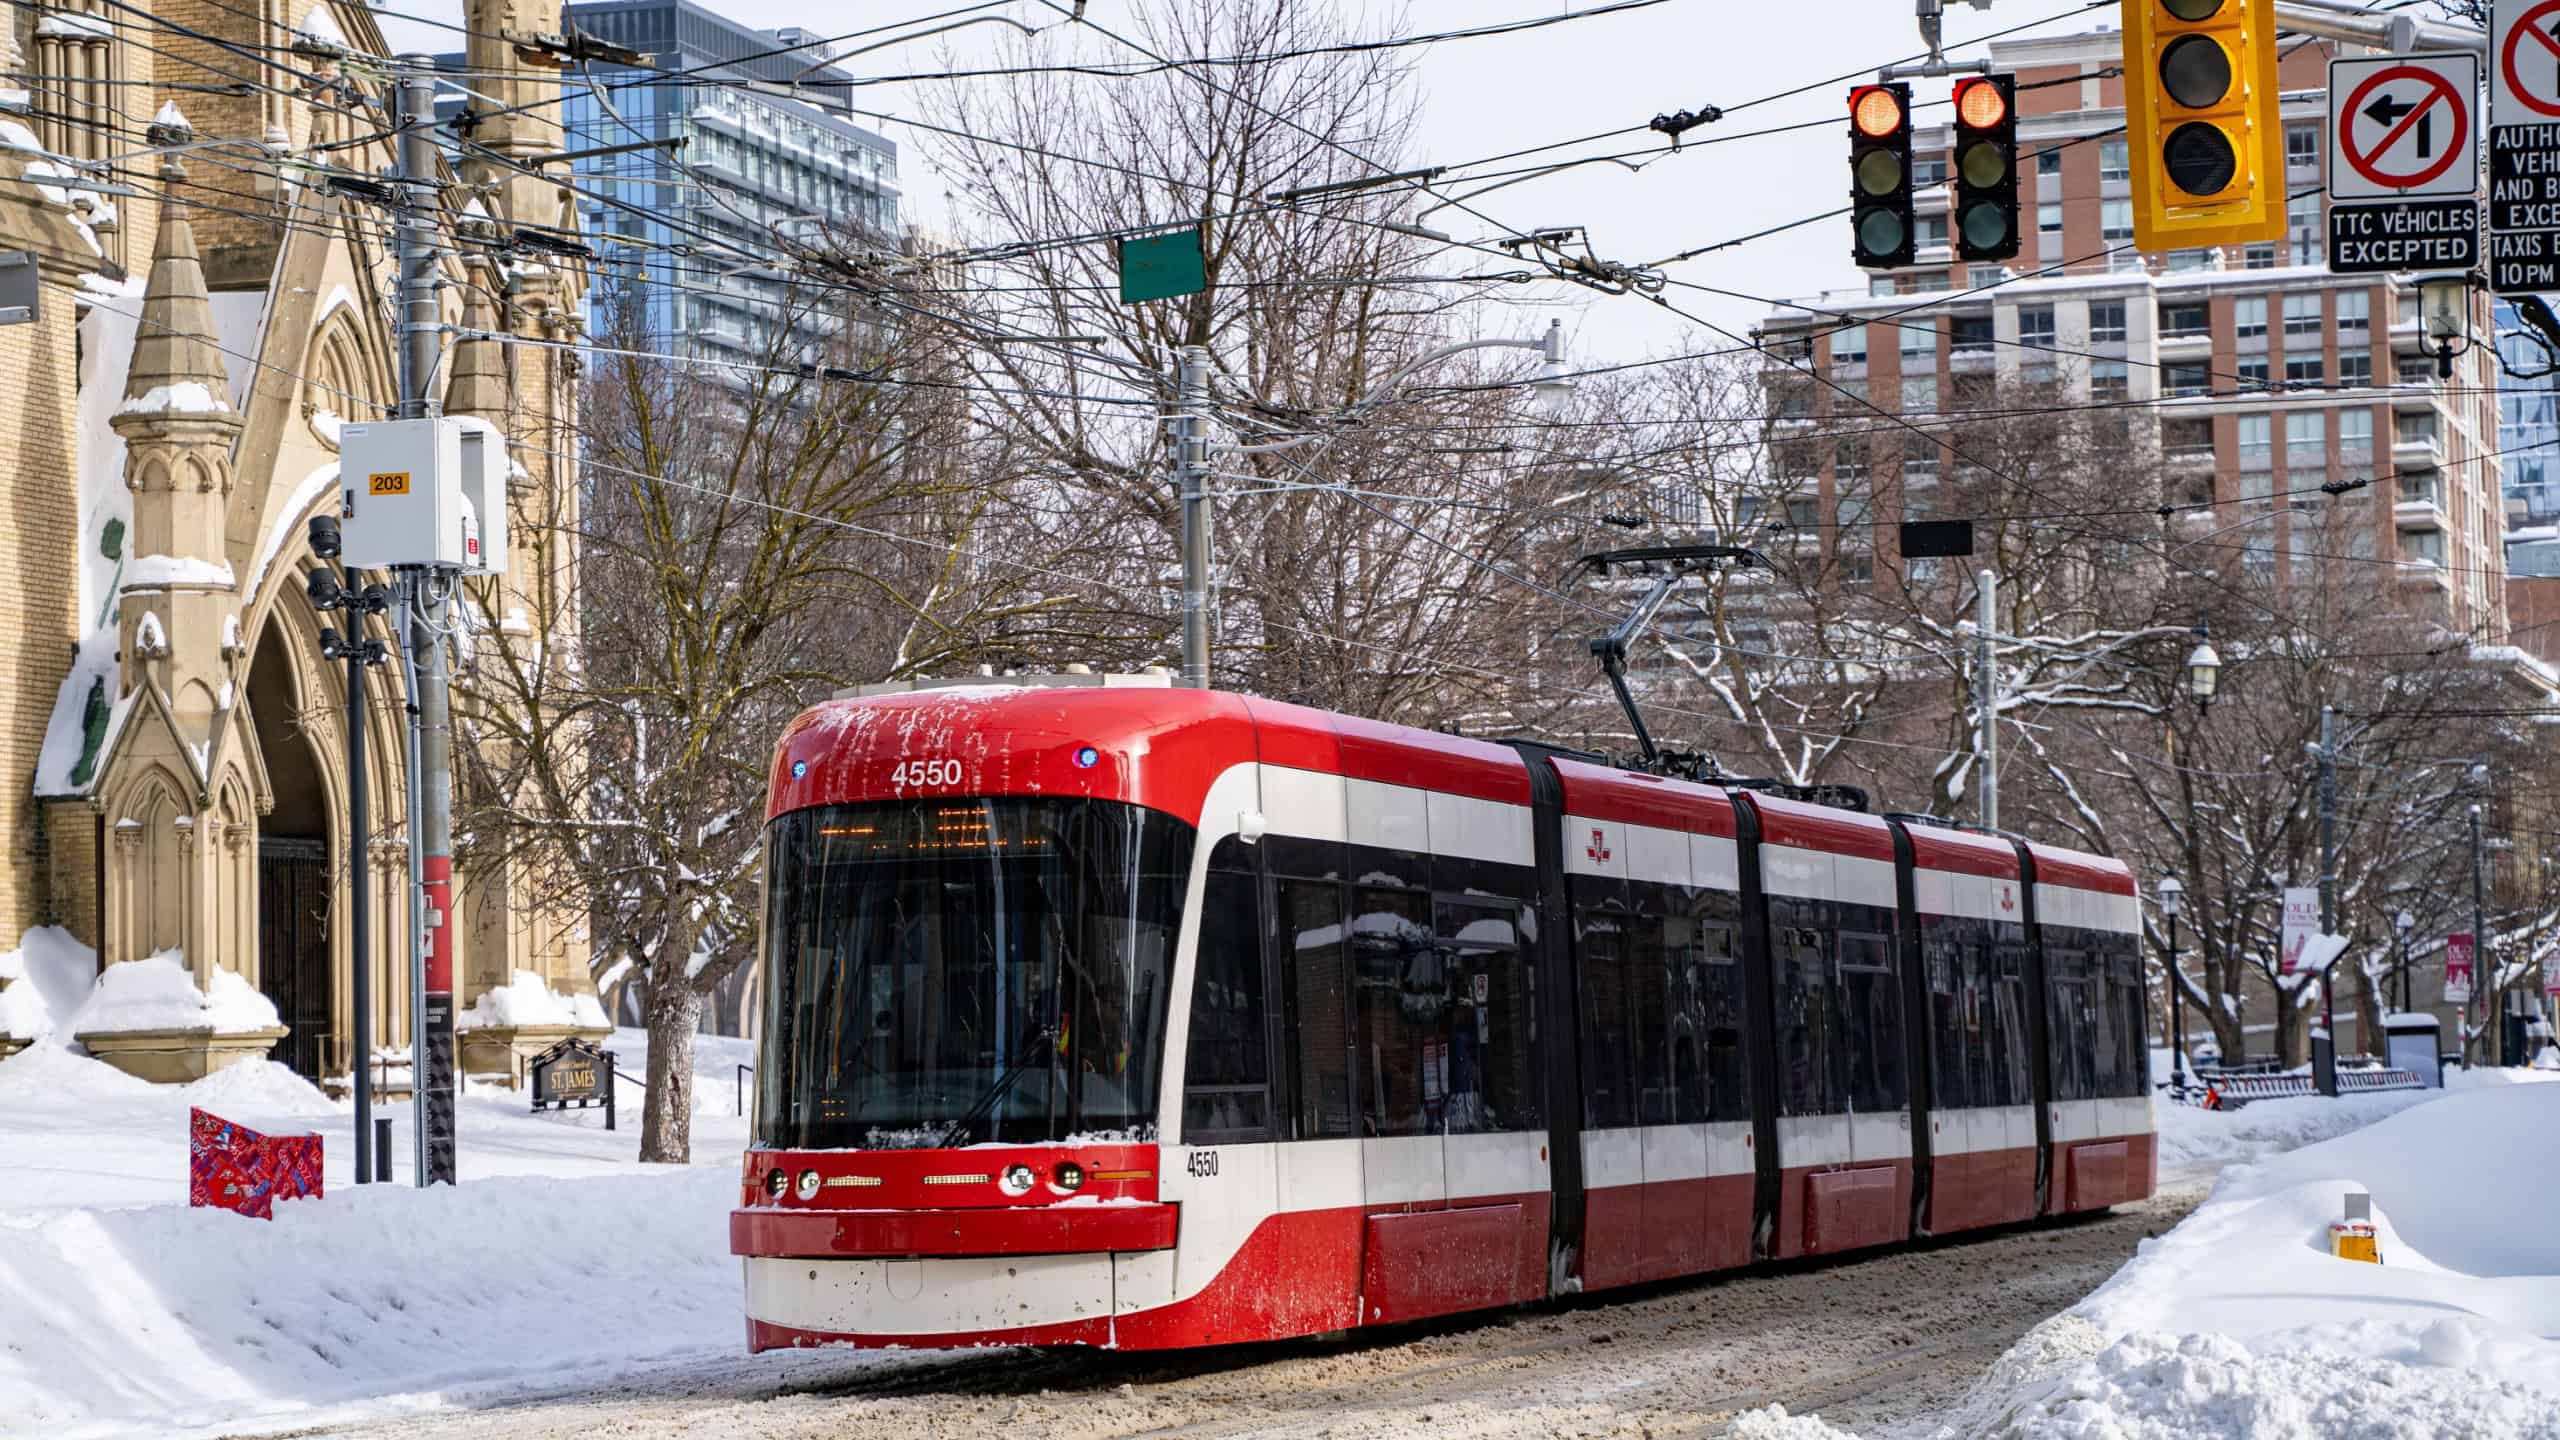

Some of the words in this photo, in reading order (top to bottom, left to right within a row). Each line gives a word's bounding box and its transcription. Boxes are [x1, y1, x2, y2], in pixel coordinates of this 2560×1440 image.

[2494, 178, 2534, 201] AND
[2333, 212, 2372, 236] TTC
[2381, 208, 2475, 235] VEHICLES
[2340, 237, 2468, 263] EXCEPTED
[2492, 234, 2542, 257] TAXIS
[2500, 263, 2523, 285] 10
[2527, 264, 2554, 284] PM
[374, 476, 403, 491] 203
[891, 759, 962, 786] 4550
[564, 1070, 596, 1092] JAMES
[1187, 1151, 1218, 1177] 4550
